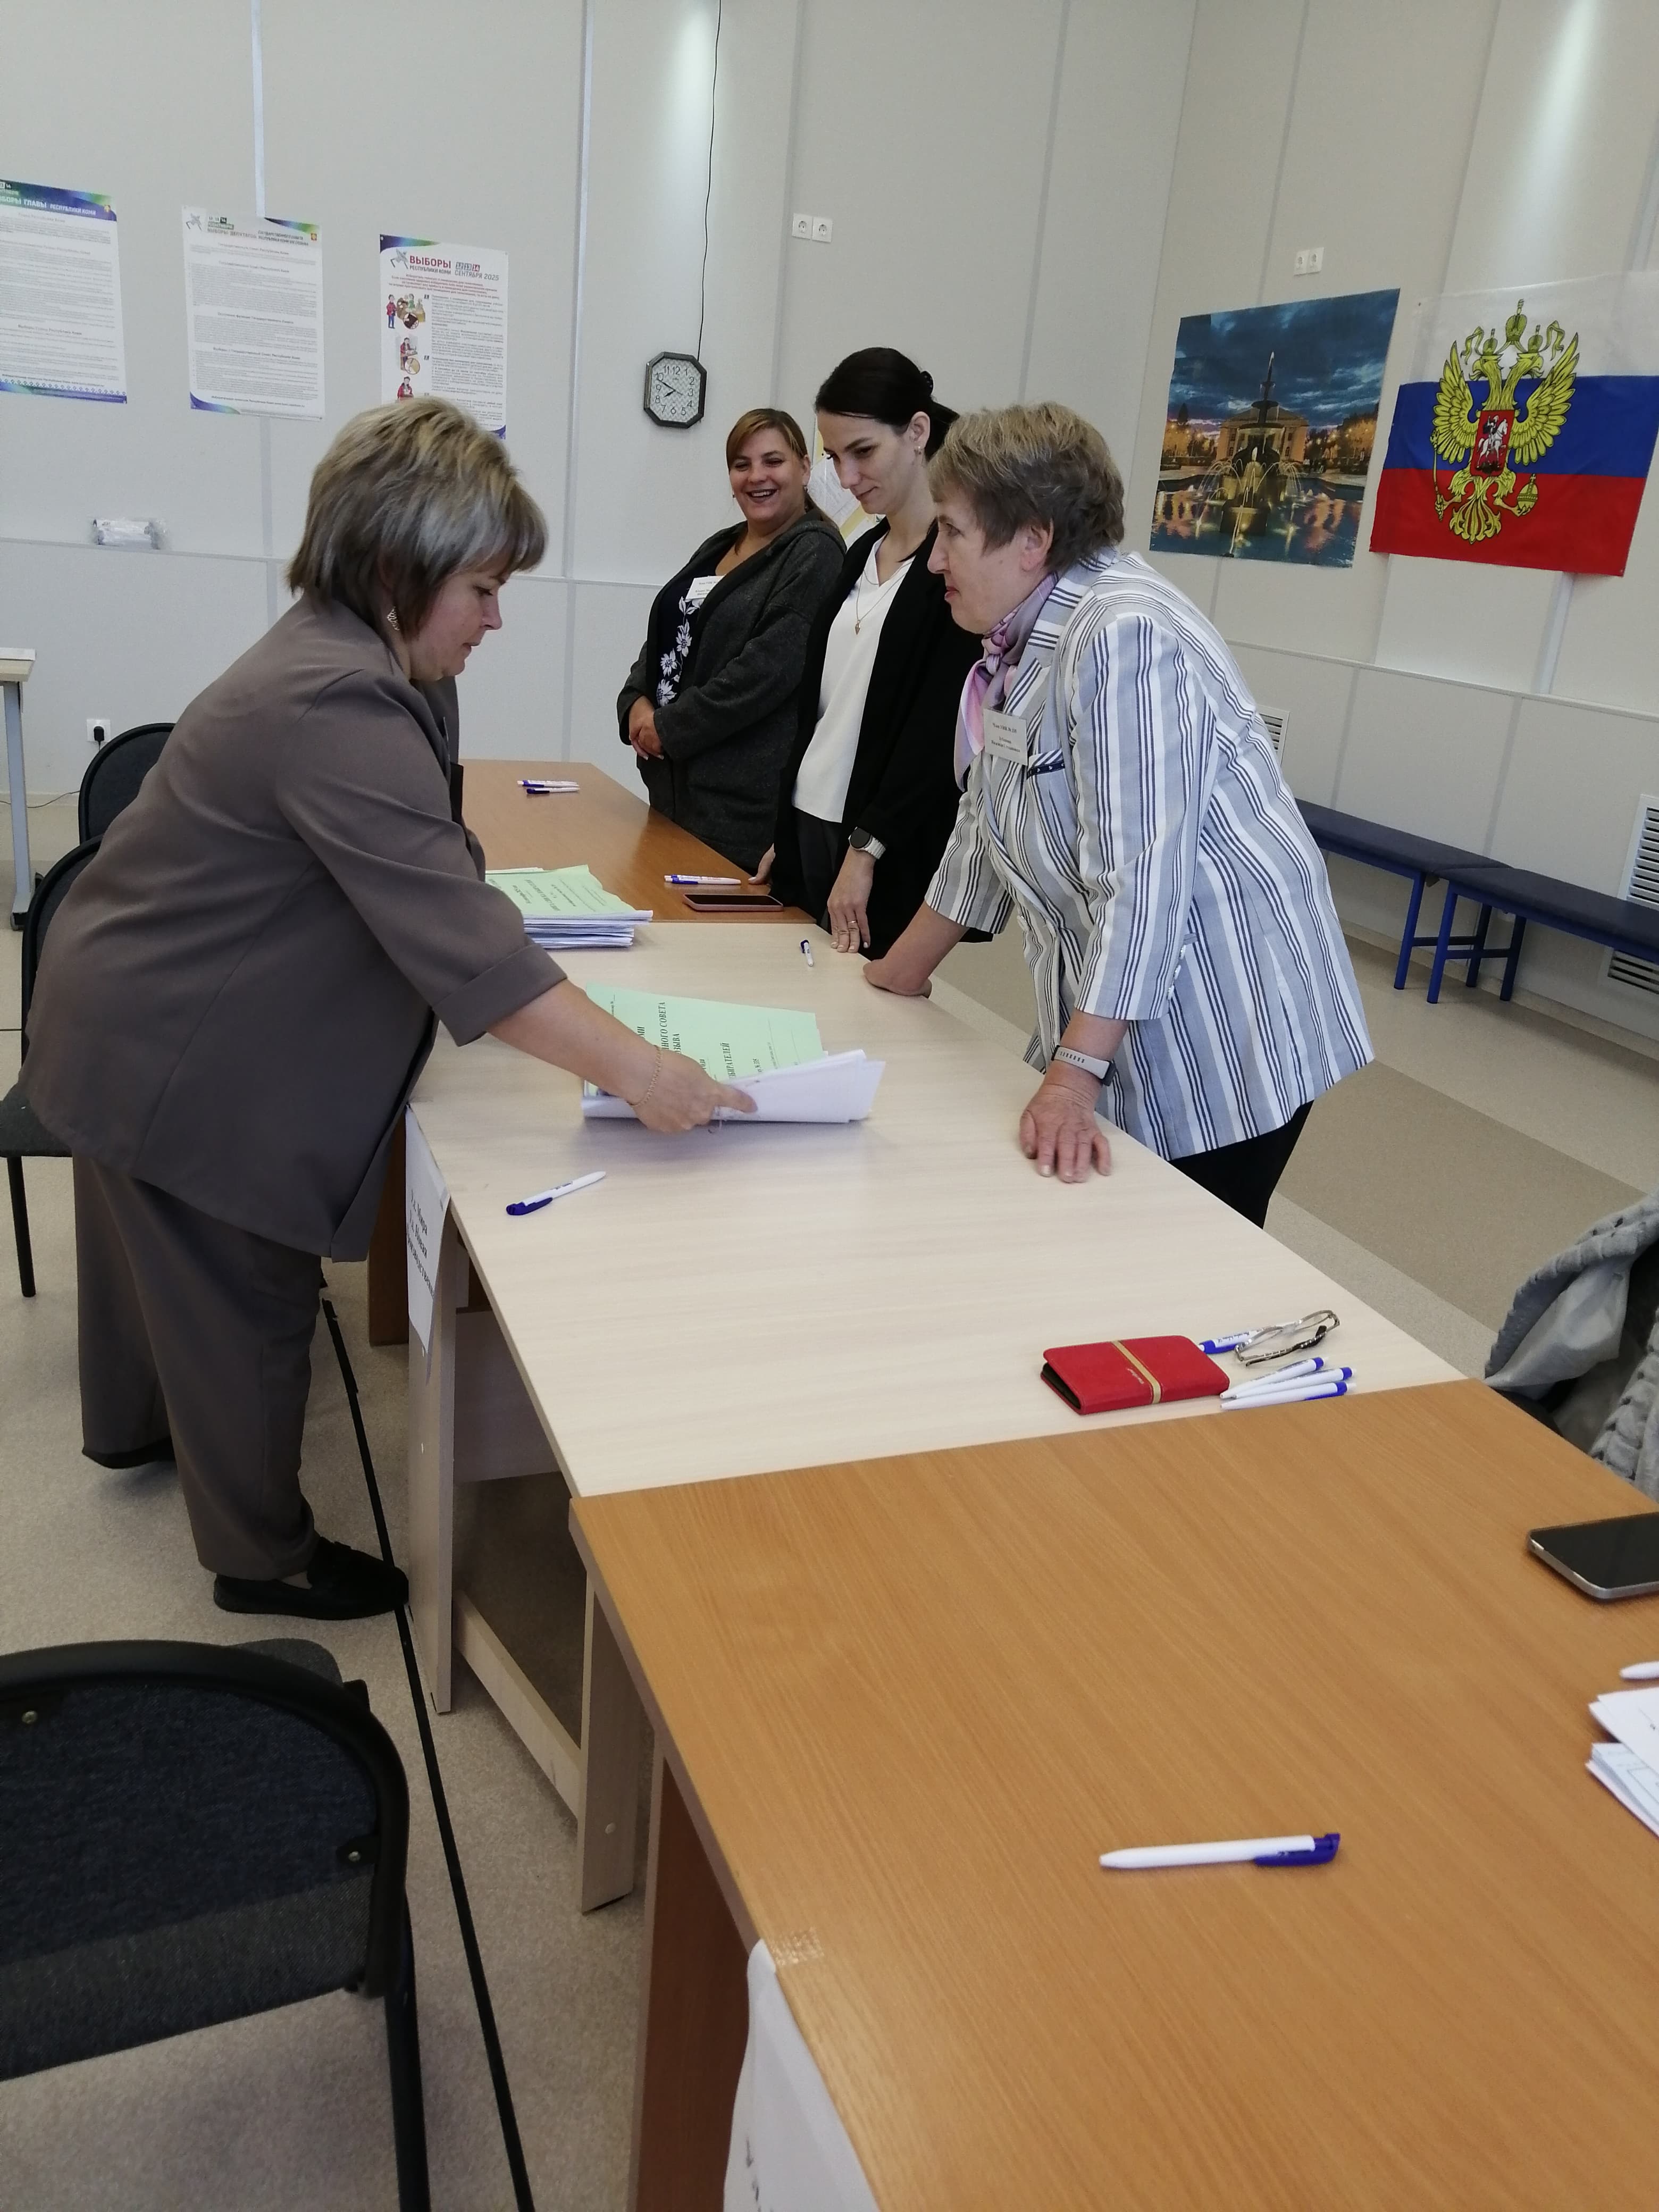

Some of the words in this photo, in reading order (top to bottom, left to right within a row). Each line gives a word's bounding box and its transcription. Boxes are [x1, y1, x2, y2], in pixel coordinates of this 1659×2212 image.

[0, 196, 21, 205] БОРЫ
[23, 199, 47, 208] ГЛАВЫ
[409, 255, 451, 269] ВЫБОРЫ
[409, 265, 438, 273] РЕСПУБЛИКИ
[455, 270, 482, 279] СЕНТЯБРЯ
[664, 366, 669, 374] 11
[672, 366, 681, 375] 12
[655, 373, 664, 381] 10
[689, 376, 694, 386] 2
[656, 384, 661, 392] 9
[688, 388, 694, 397] 3
[661, 405, 666, 413] 7
[671, 406, 676, 415] 6
[681, 407, 686, 416] 5
[658, 1002, 667, 1027] СОВЕТА
[417, 1203, 428, 1235] Мира
[415, 1224, 428, 1259] Новая
